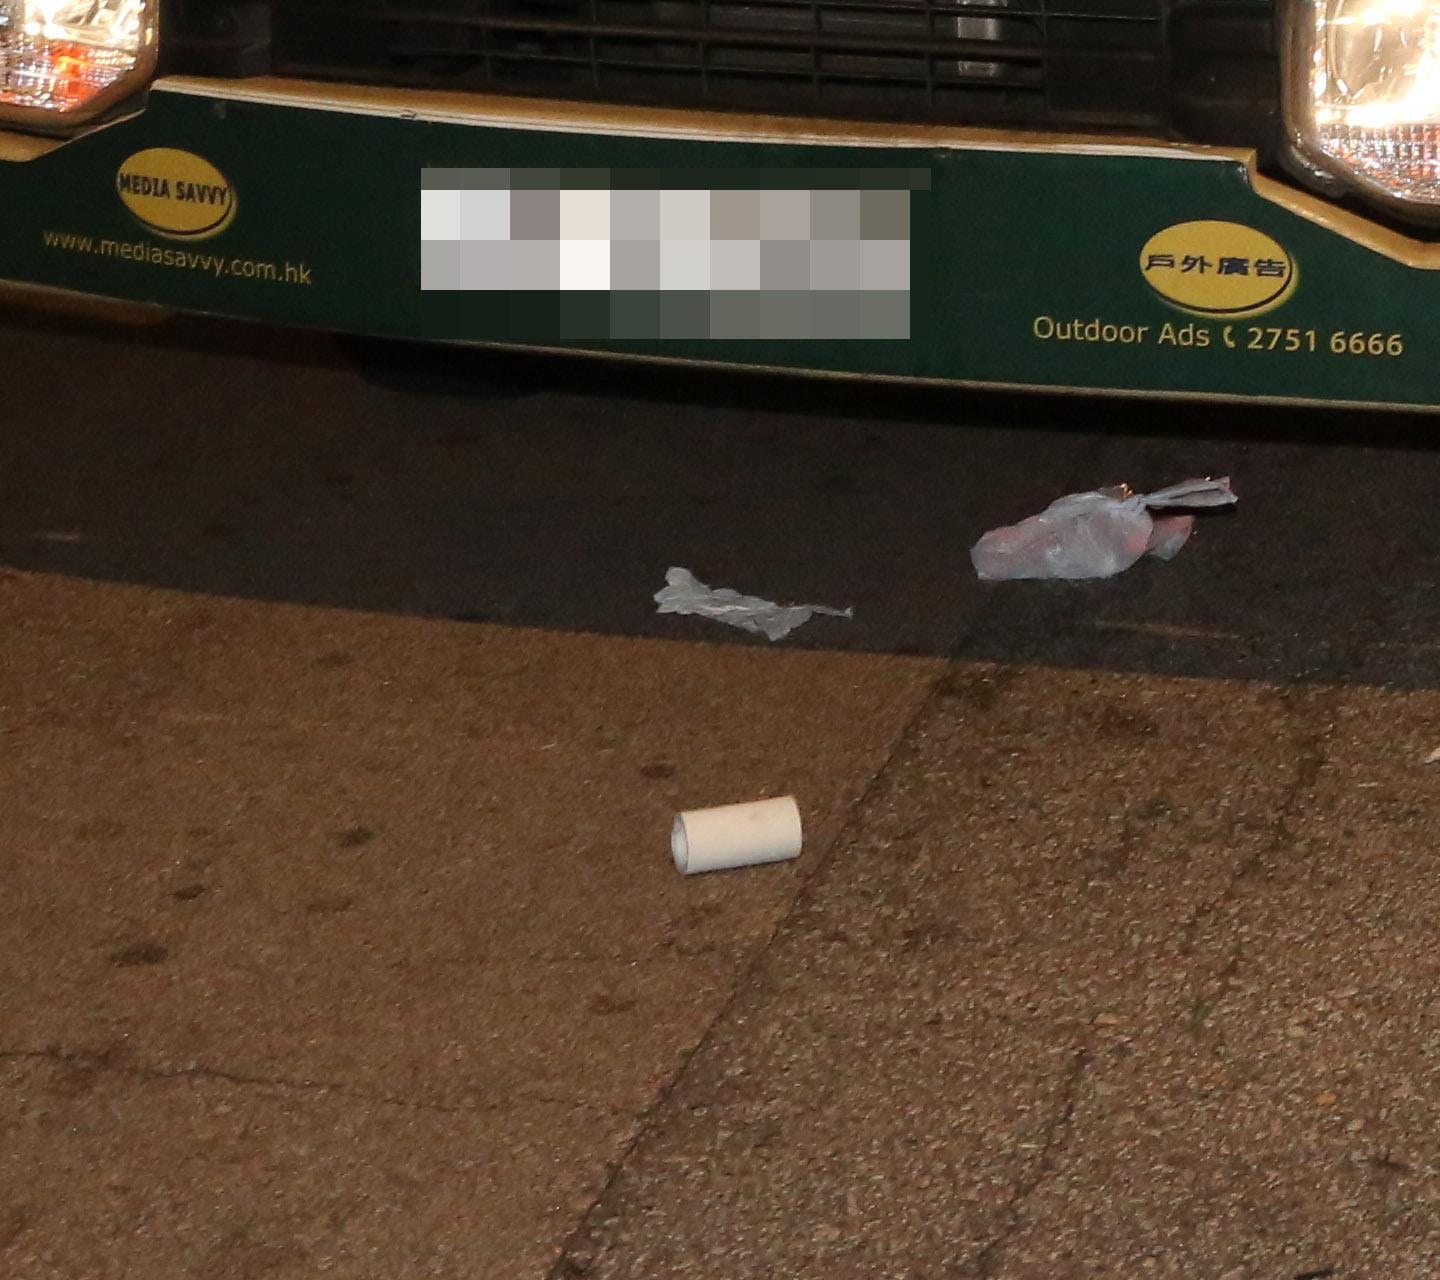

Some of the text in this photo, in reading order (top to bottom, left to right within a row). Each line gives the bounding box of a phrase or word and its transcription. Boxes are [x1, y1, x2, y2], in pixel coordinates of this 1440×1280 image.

[118, 171, 228, 207] MEDIA SAVVY
[42, 228, 313, 286] www.mediasavvy.com.hk
[1145, 253, 1286, 278] 戶外廣告
[1033, 315, 1404, 358] Outdoor Ads 2751 6666
